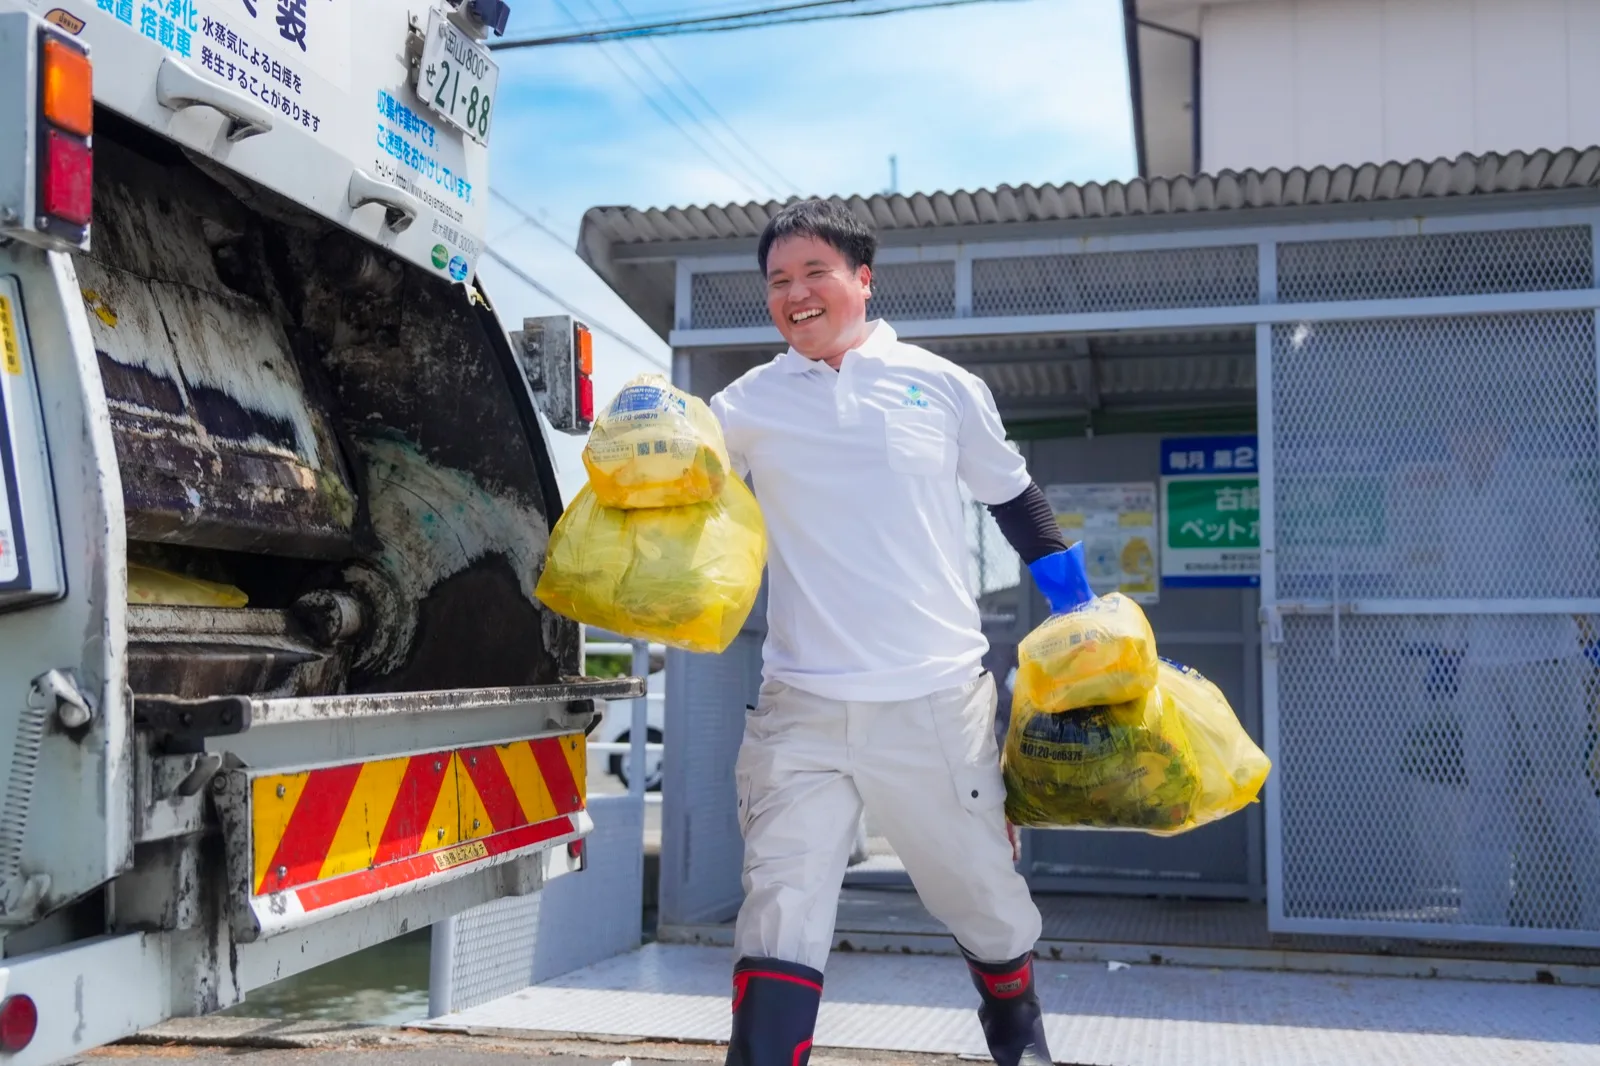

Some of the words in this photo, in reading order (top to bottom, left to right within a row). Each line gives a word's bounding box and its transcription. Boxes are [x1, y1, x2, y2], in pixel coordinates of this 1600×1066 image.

[140, 3, 192, 57] 搭載車
[202, 15, 302, 94] 水蒸気による白煙を
[201, 45, 321, 132] 発生することがあります
[425, 63, 436, 86] せ
[435, 60, 490, 137] 21-88
